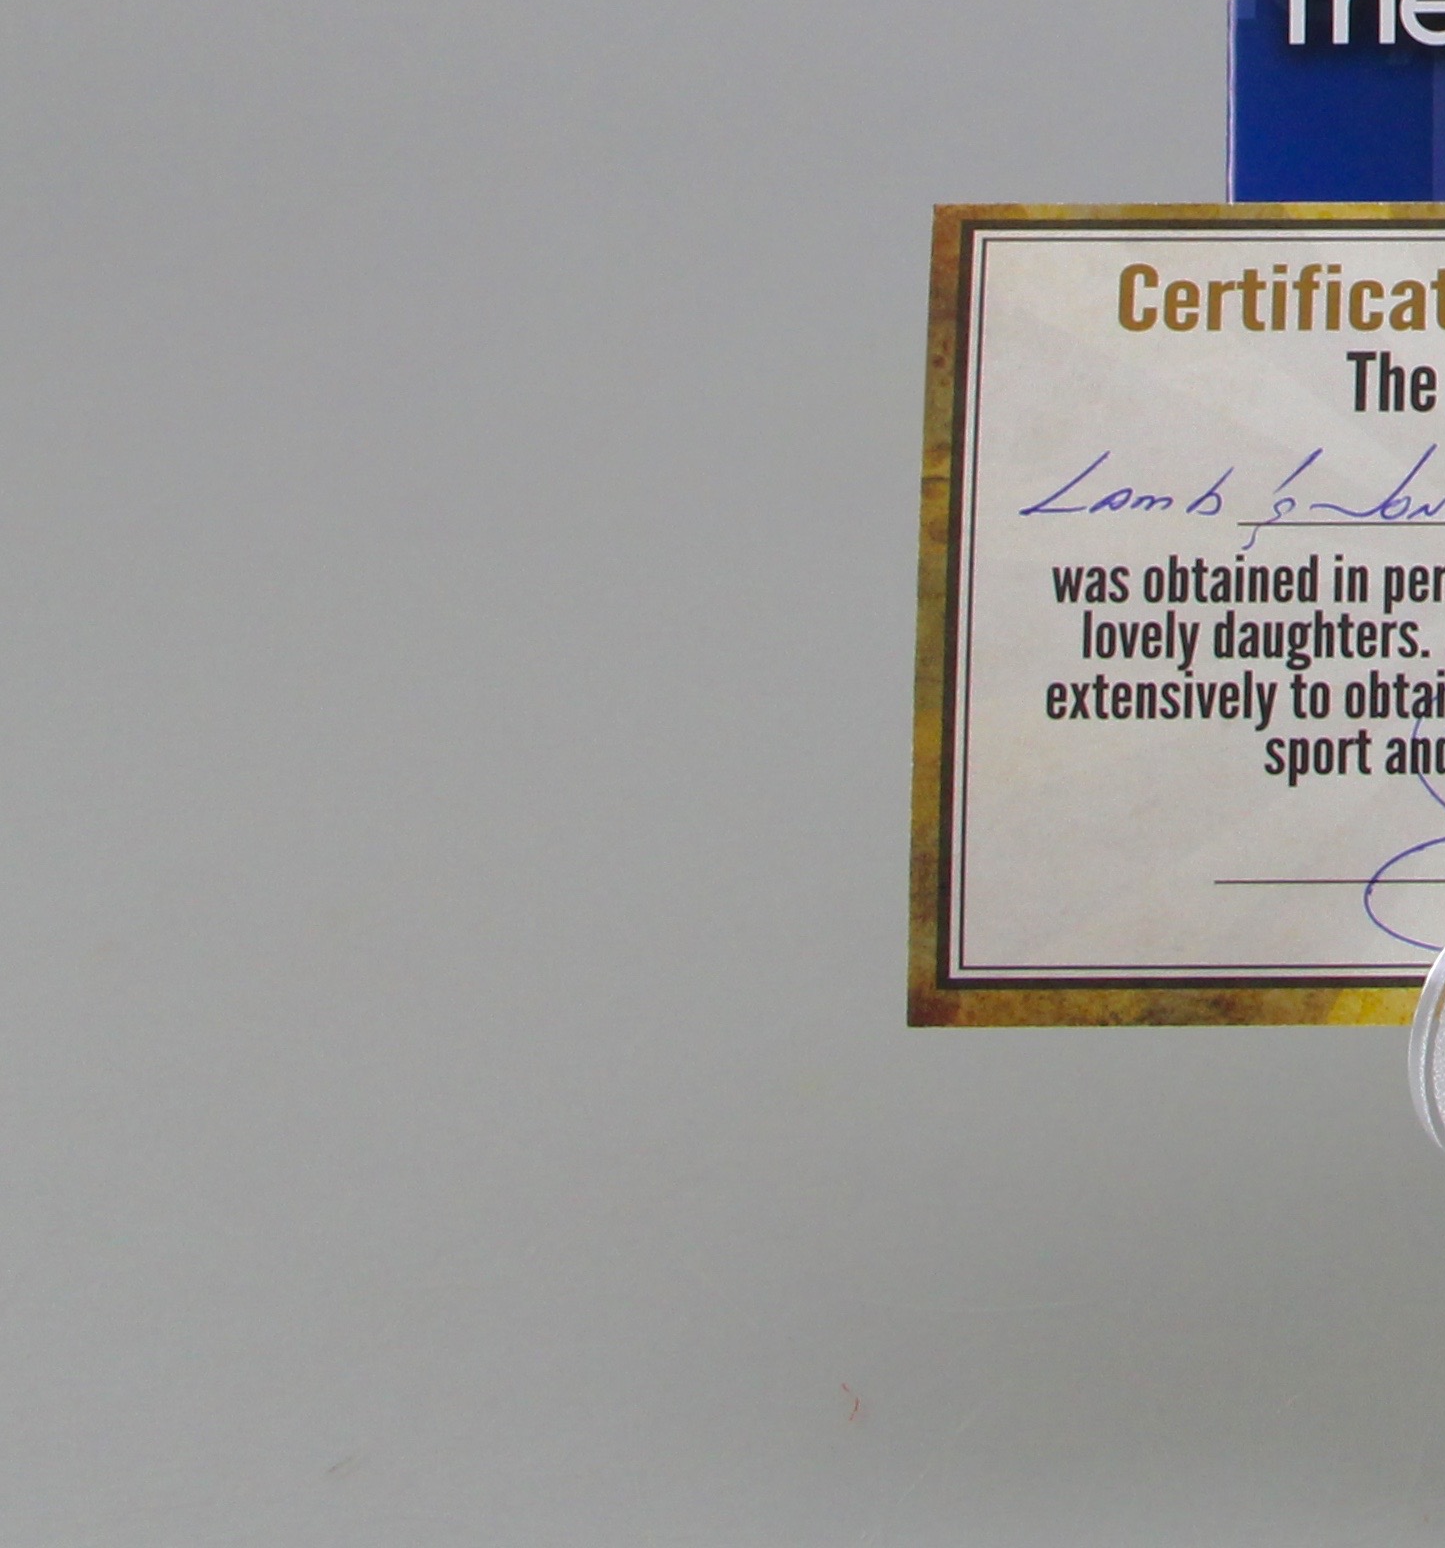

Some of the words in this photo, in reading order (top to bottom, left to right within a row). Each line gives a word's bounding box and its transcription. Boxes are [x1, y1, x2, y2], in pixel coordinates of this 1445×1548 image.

[1347, 350, 1437, 413] The
[1052, 564, 1130, 604] was
[1142, 554, 1320, 604] obtained
[1334, 554, 1367, 603] in
[1082, 610, 1201, 671] lovely
[1213, 609, 1431, 670] daughters.
[1045, 670, 1279, 731] extensively
[1292, 674, 1332, 720] to
[1264, 728, 1373, 788] sport
